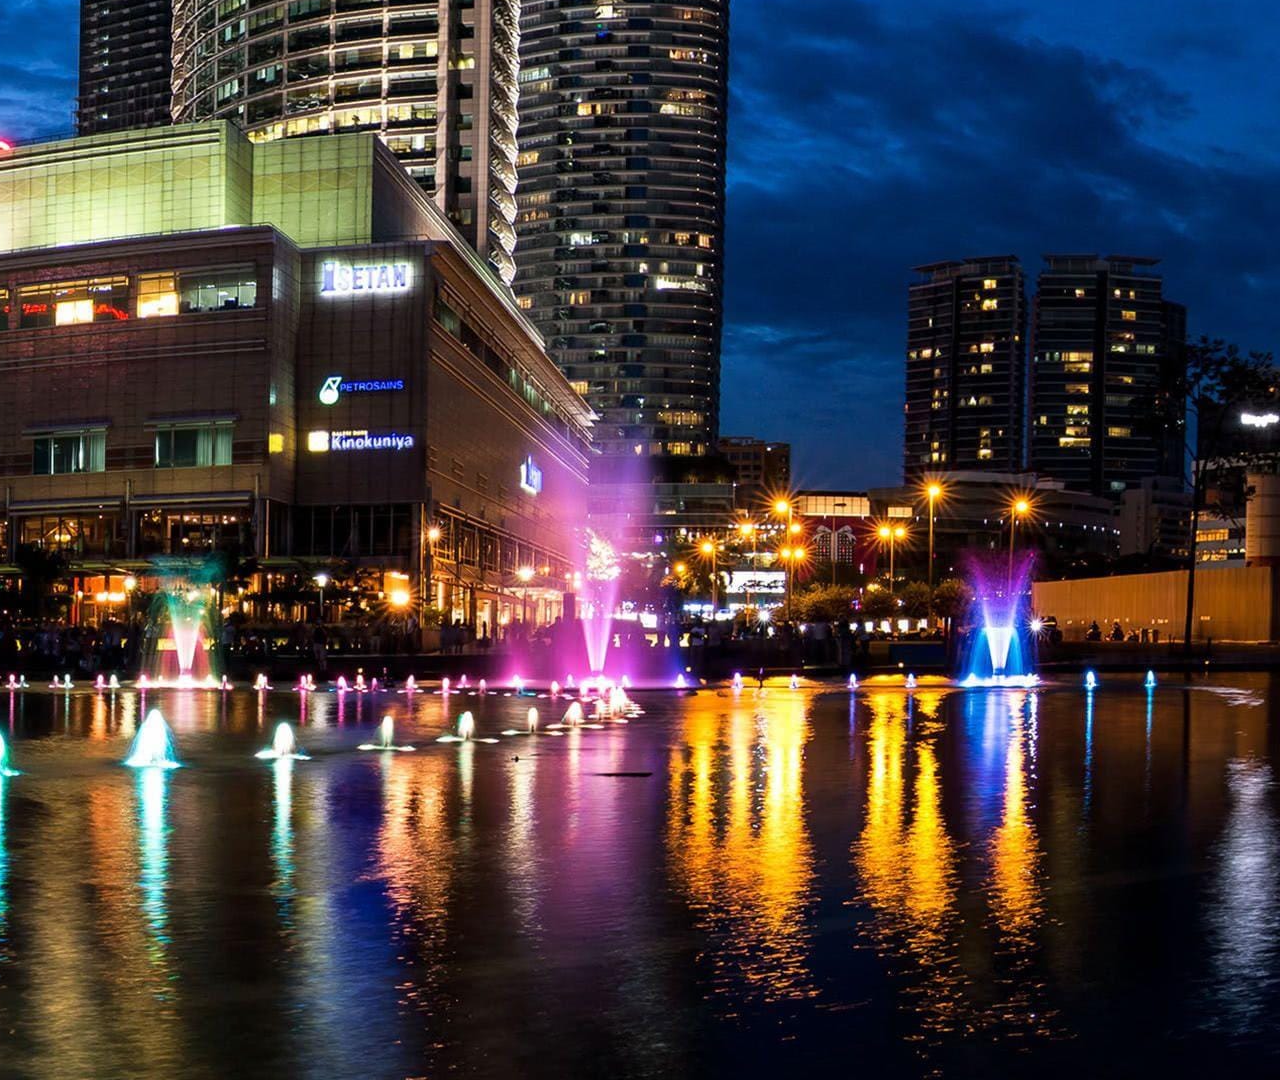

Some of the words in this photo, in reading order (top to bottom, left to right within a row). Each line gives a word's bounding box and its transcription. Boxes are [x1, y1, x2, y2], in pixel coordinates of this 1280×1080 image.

[320, 261, 408, 293] ISETAN
[340, 380, 403, 392] PETROSAINS
[331, 432, 414, 450] Kinokuniya
